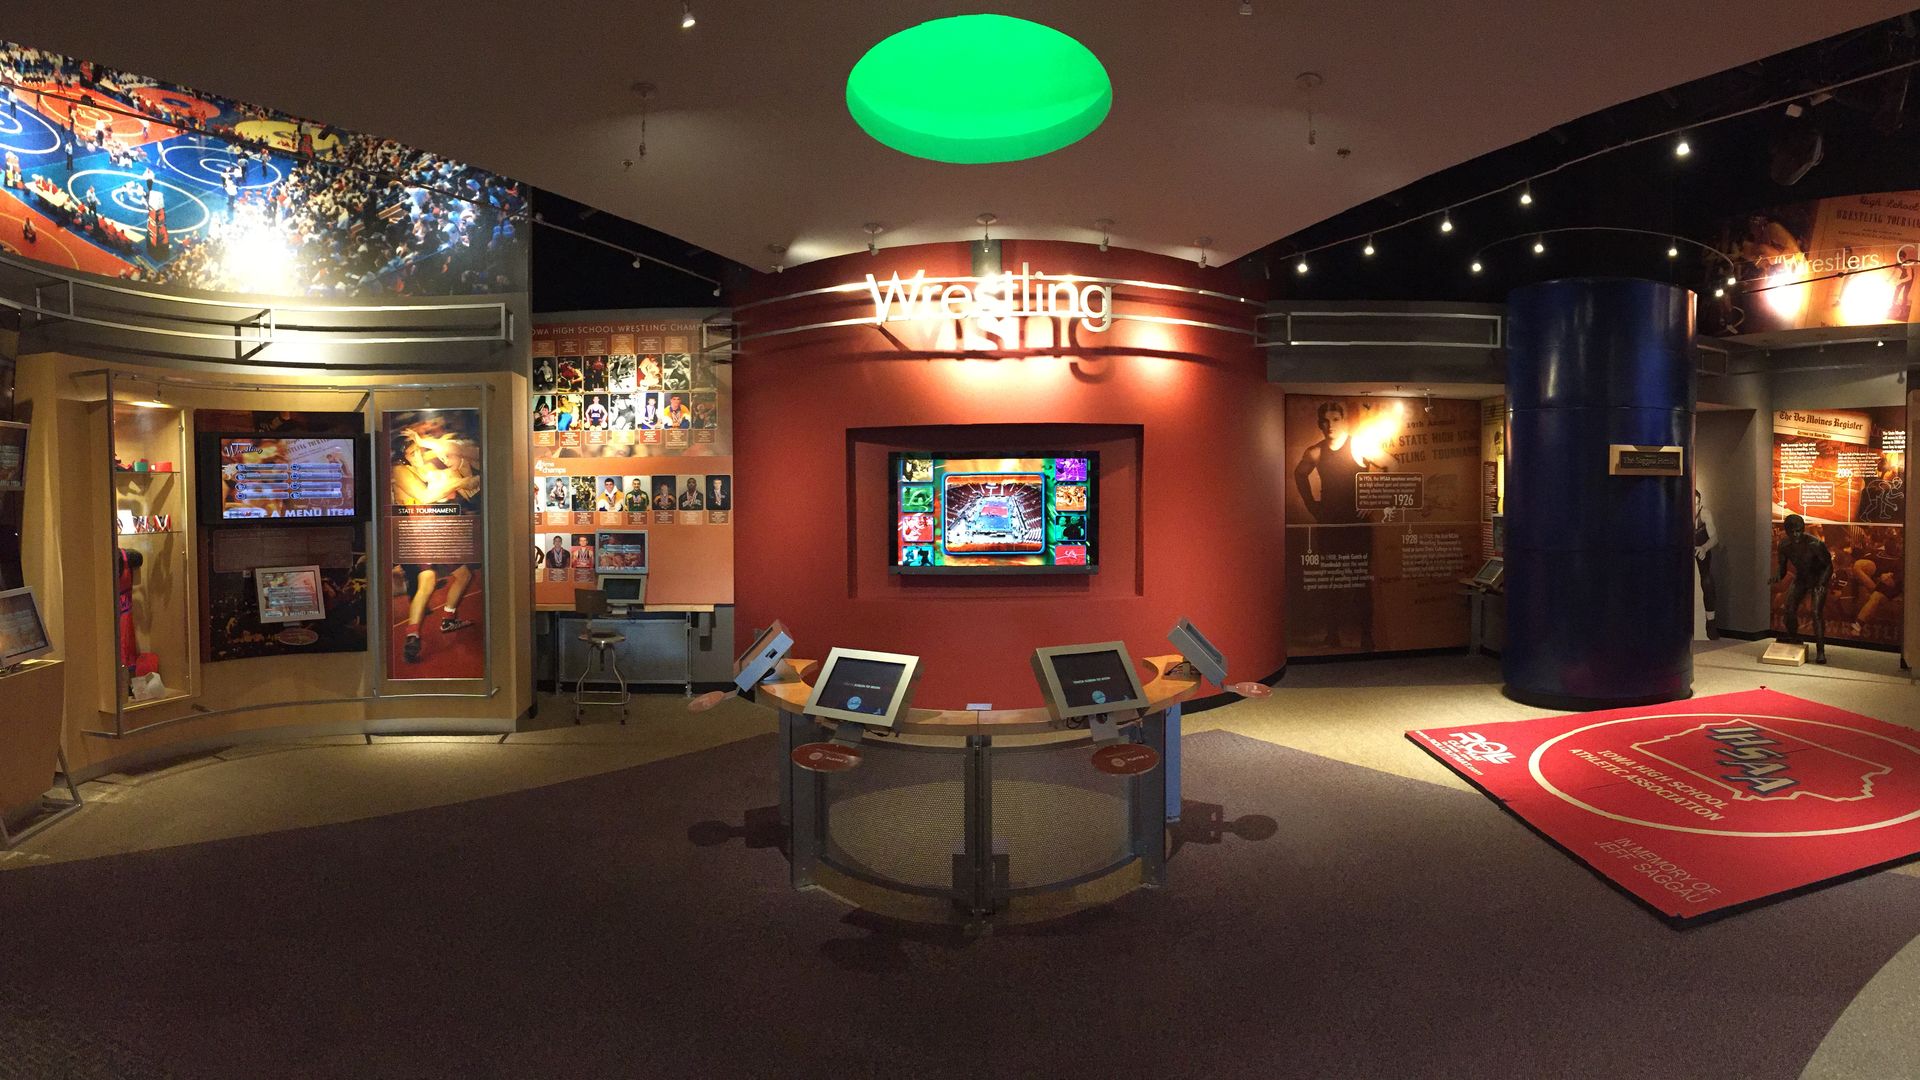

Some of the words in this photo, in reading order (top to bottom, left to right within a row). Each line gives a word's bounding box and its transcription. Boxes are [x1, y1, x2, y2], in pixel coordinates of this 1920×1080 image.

[865, 262, 1112, 332] Wrestling
[531, 327, 549, 336] OWA
[552, 327, 575, 335] HIGH
[577, 325, 614, 334] SCHOOL
[617, 324, 666, 333] WRESTLING
[1780, 411, 1792, 421] The
[1793, 412, 1806, 423] Des
[1806, 414, 1833, 427] Moines
[1833, 418, 1864, 431] Register
[1398, 433, 1428, 447] STATE
[1394, 494, 1414, 506] 1926
[285, 508, 322, 518] MENU
[327, 508, 355, 517] ITEM
[1401, 534, 1418, 544] 1928
[1300, 554, 1320, 566] 1908
[1706, 725, 1800, 796] IHSAA
[1569, 748, 1630, 776] ATHLETIC
[1620, 774, 1725, 821] ASSOCIATION
[1596, 750, 1637, 766] IOWA
[1632, 764, 1670, 783] HIGH
[1667, 780, 1729, 810] SCHOOL
[1594, 841, 1638, 860] JEFF
[1633, 862, 1708, 903] SAGGAU
[1615, 837, 1636, 848] IN
[1630, 846, 1697, 882] MEMORY
[1691, 882, 1722, 896] OF
